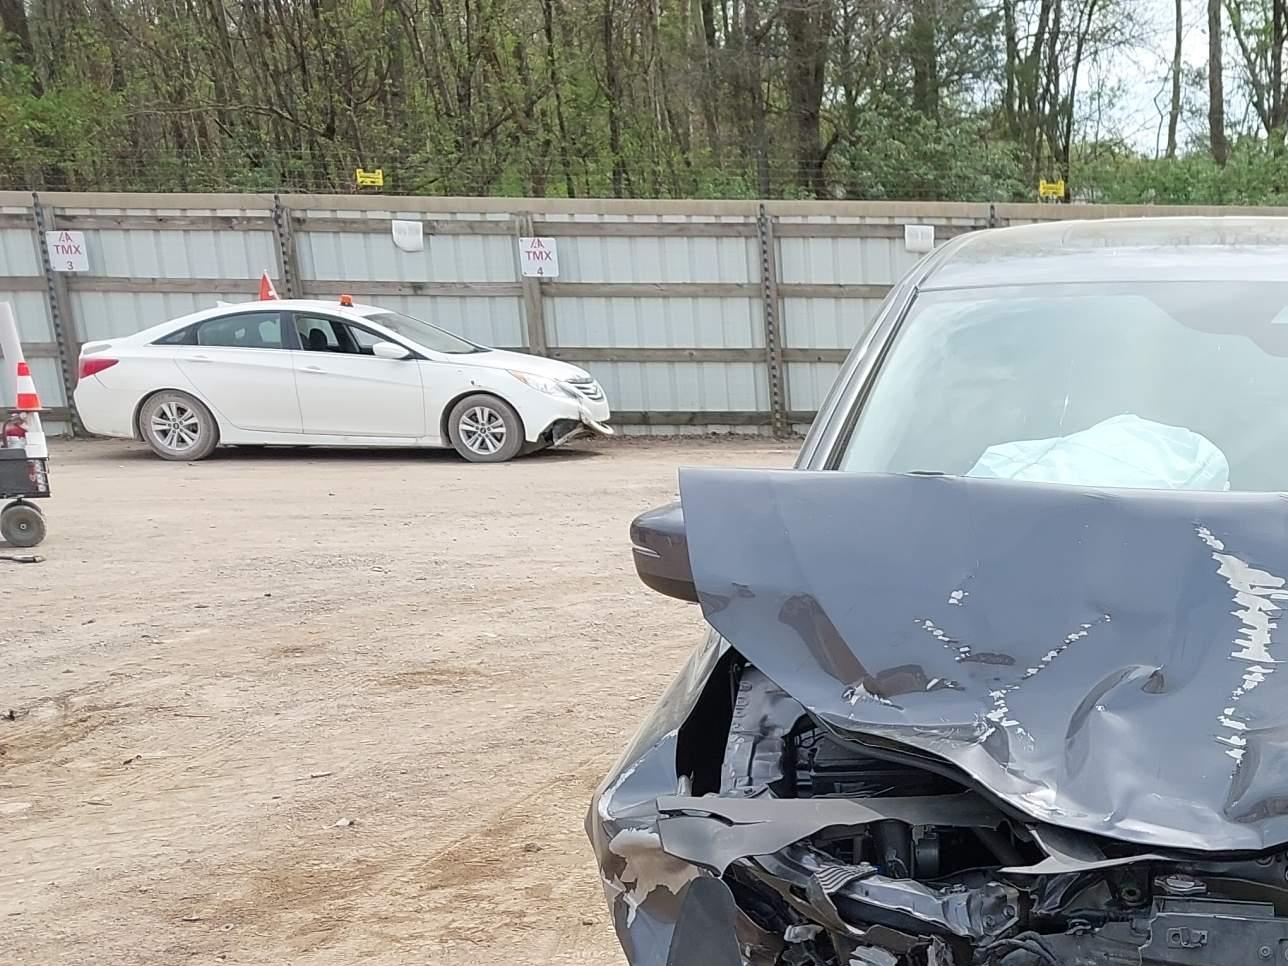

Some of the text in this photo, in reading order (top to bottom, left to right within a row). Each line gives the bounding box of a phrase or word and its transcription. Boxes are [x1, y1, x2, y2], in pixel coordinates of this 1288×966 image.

[53, 244, 82, 255] TMX
[524, 250, 553, 261] TMX
[66, 260, 74, 270] 3
[536, 266, 544, 275] 4
